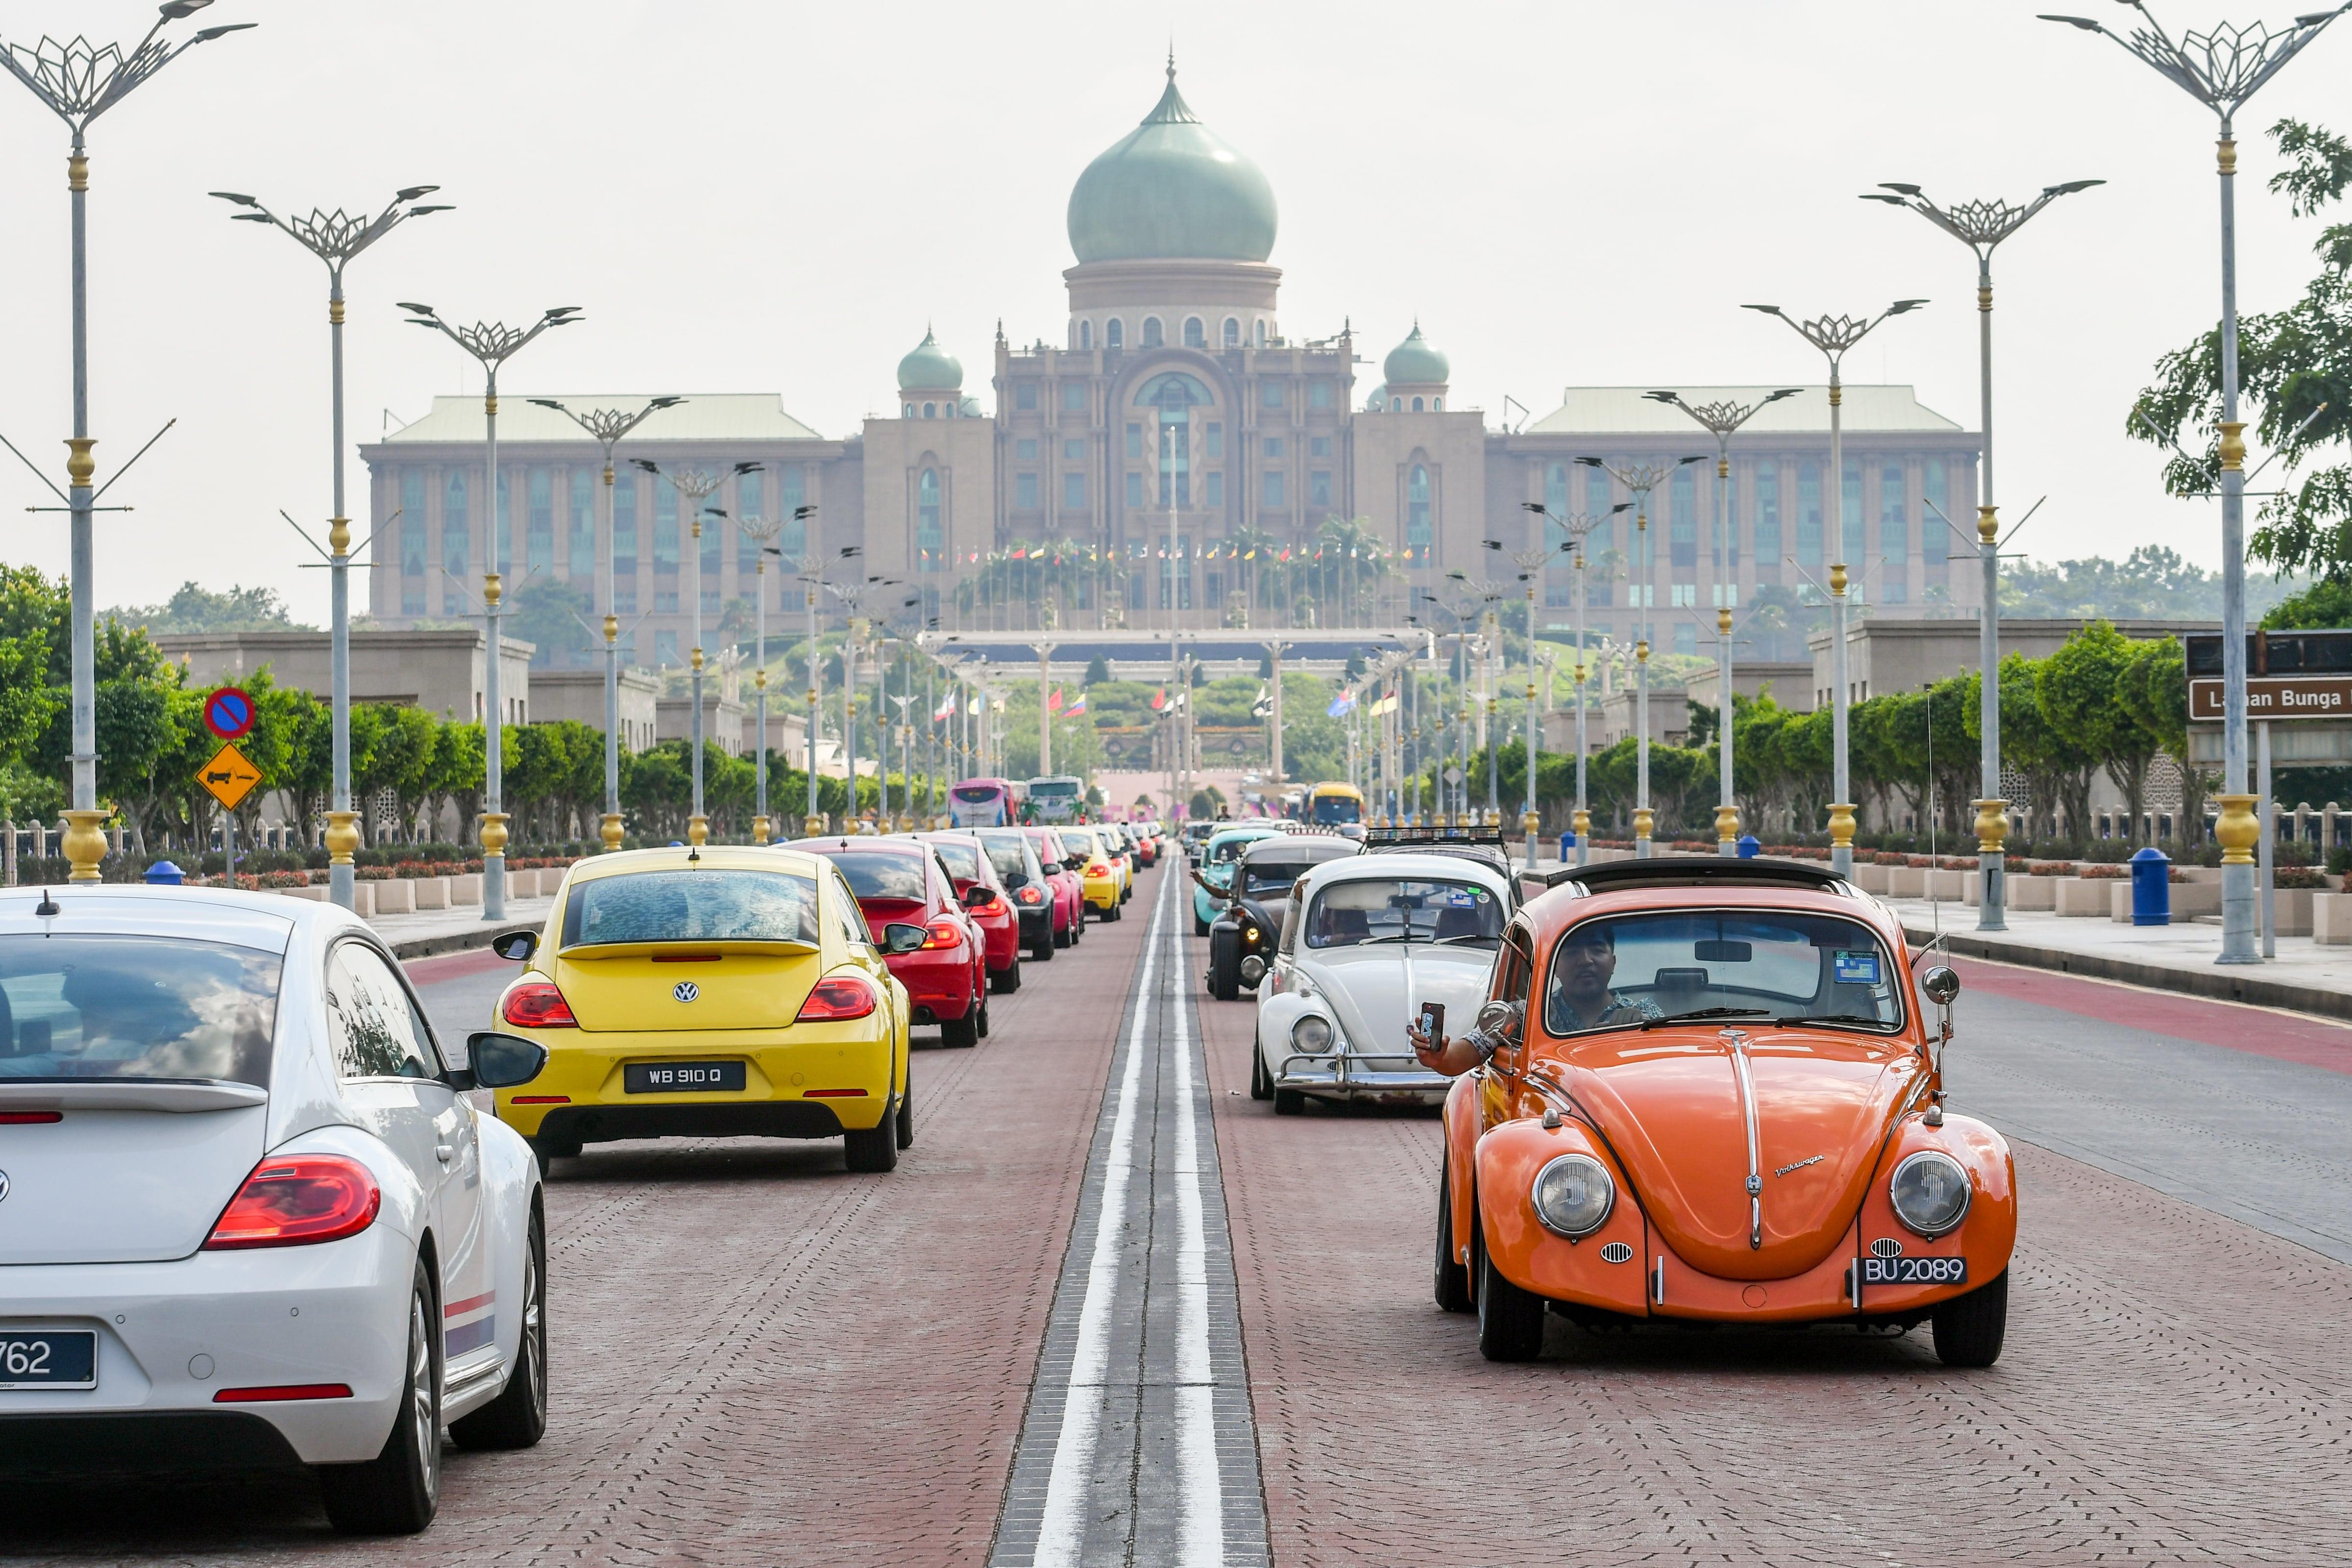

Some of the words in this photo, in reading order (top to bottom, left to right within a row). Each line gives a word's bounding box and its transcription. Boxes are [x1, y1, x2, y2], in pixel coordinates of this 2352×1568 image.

[2210, 691, 2272, 707] Lan
[2281, 689, 2341, 709] Bunga
[650, 1070, 673, 1083] WB
[678, 1070, 705, 1082] 910
[710, 1069, 721, 1081] Q
[1775, 1155, 1824, 1177] Volkswagen
